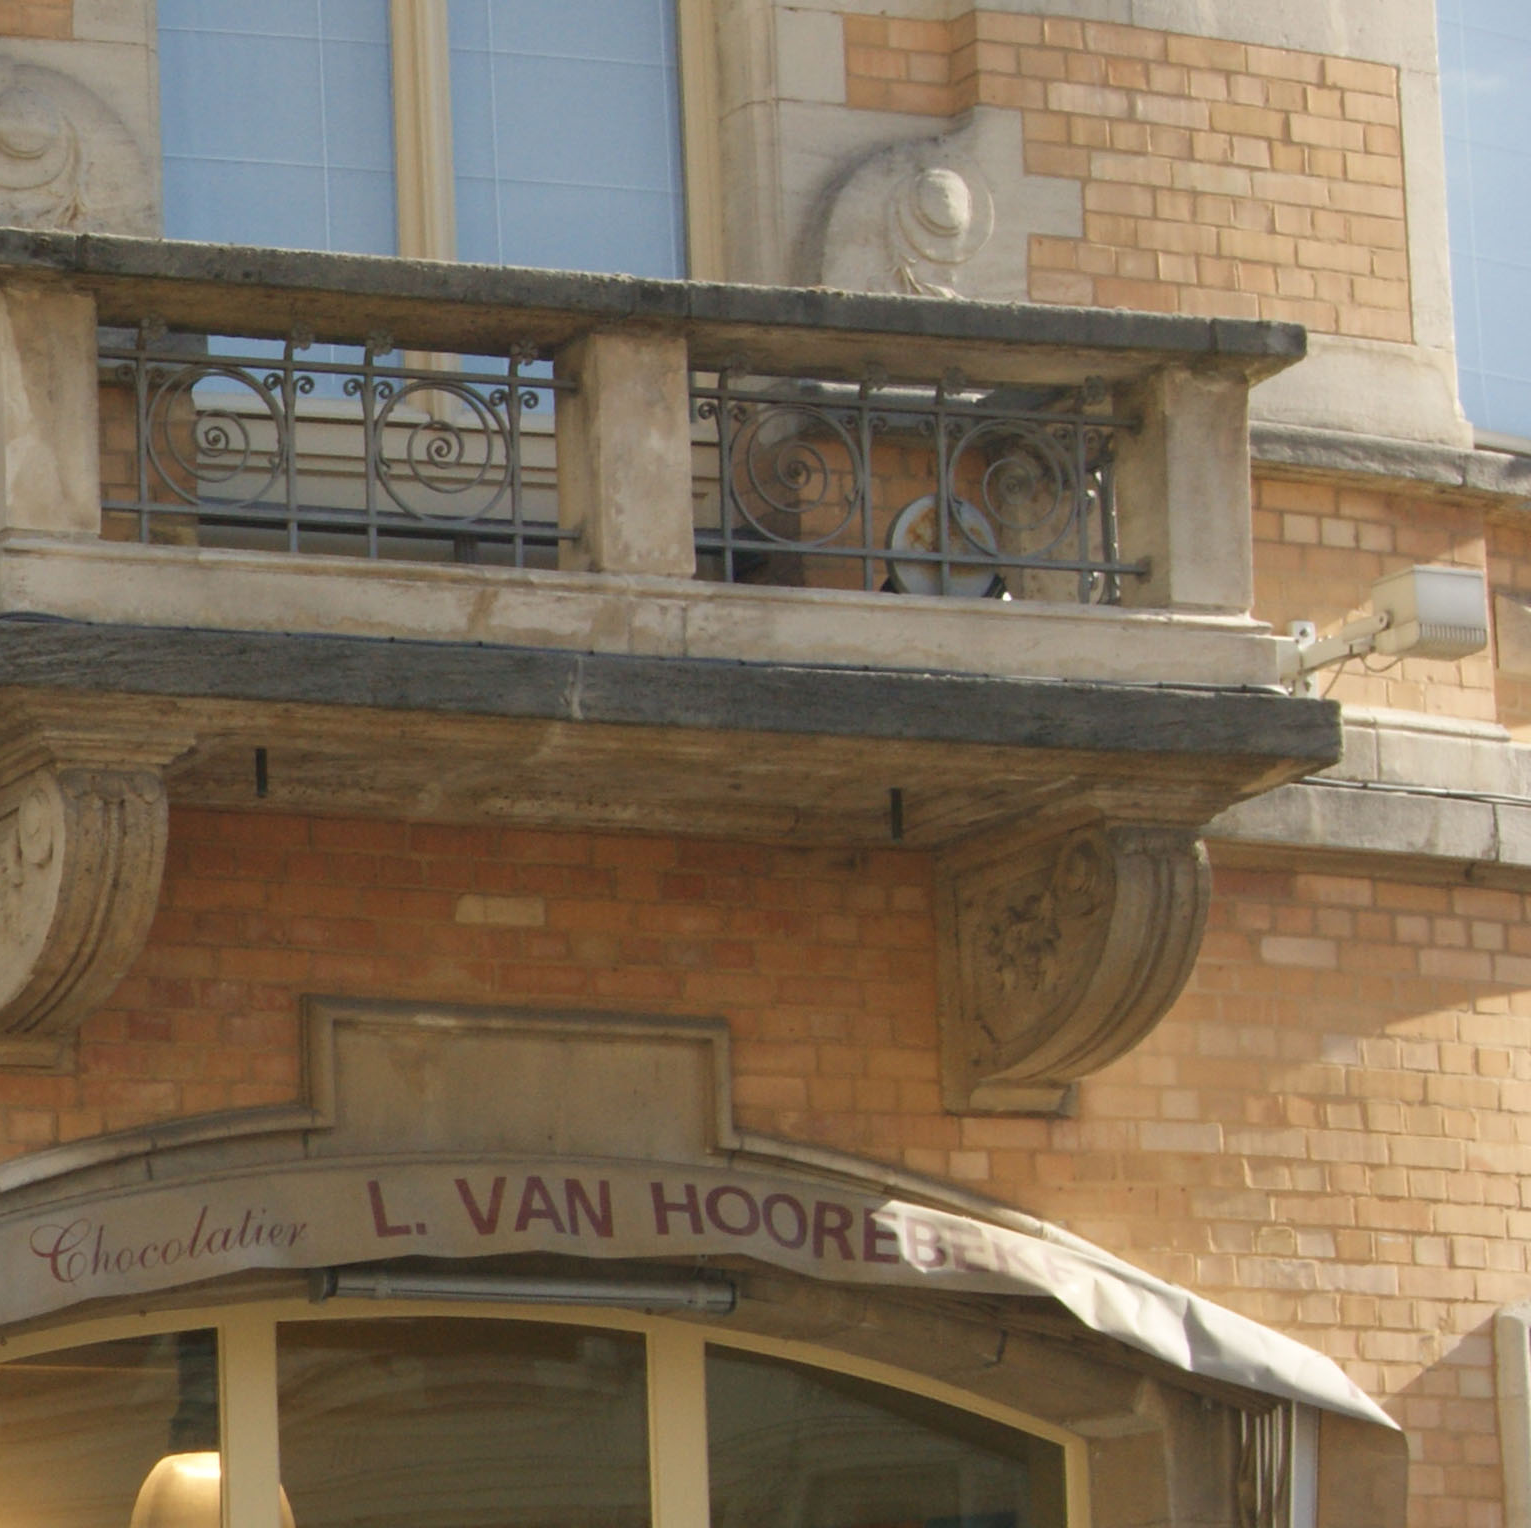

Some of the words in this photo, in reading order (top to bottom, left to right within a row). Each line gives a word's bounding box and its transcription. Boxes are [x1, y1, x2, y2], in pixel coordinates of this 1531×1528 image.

[29, 1204, 309, 1284] Chocolatier
[367, 1178, 428, 1239] L.
[453, 1174, 615, 1239] VAN
